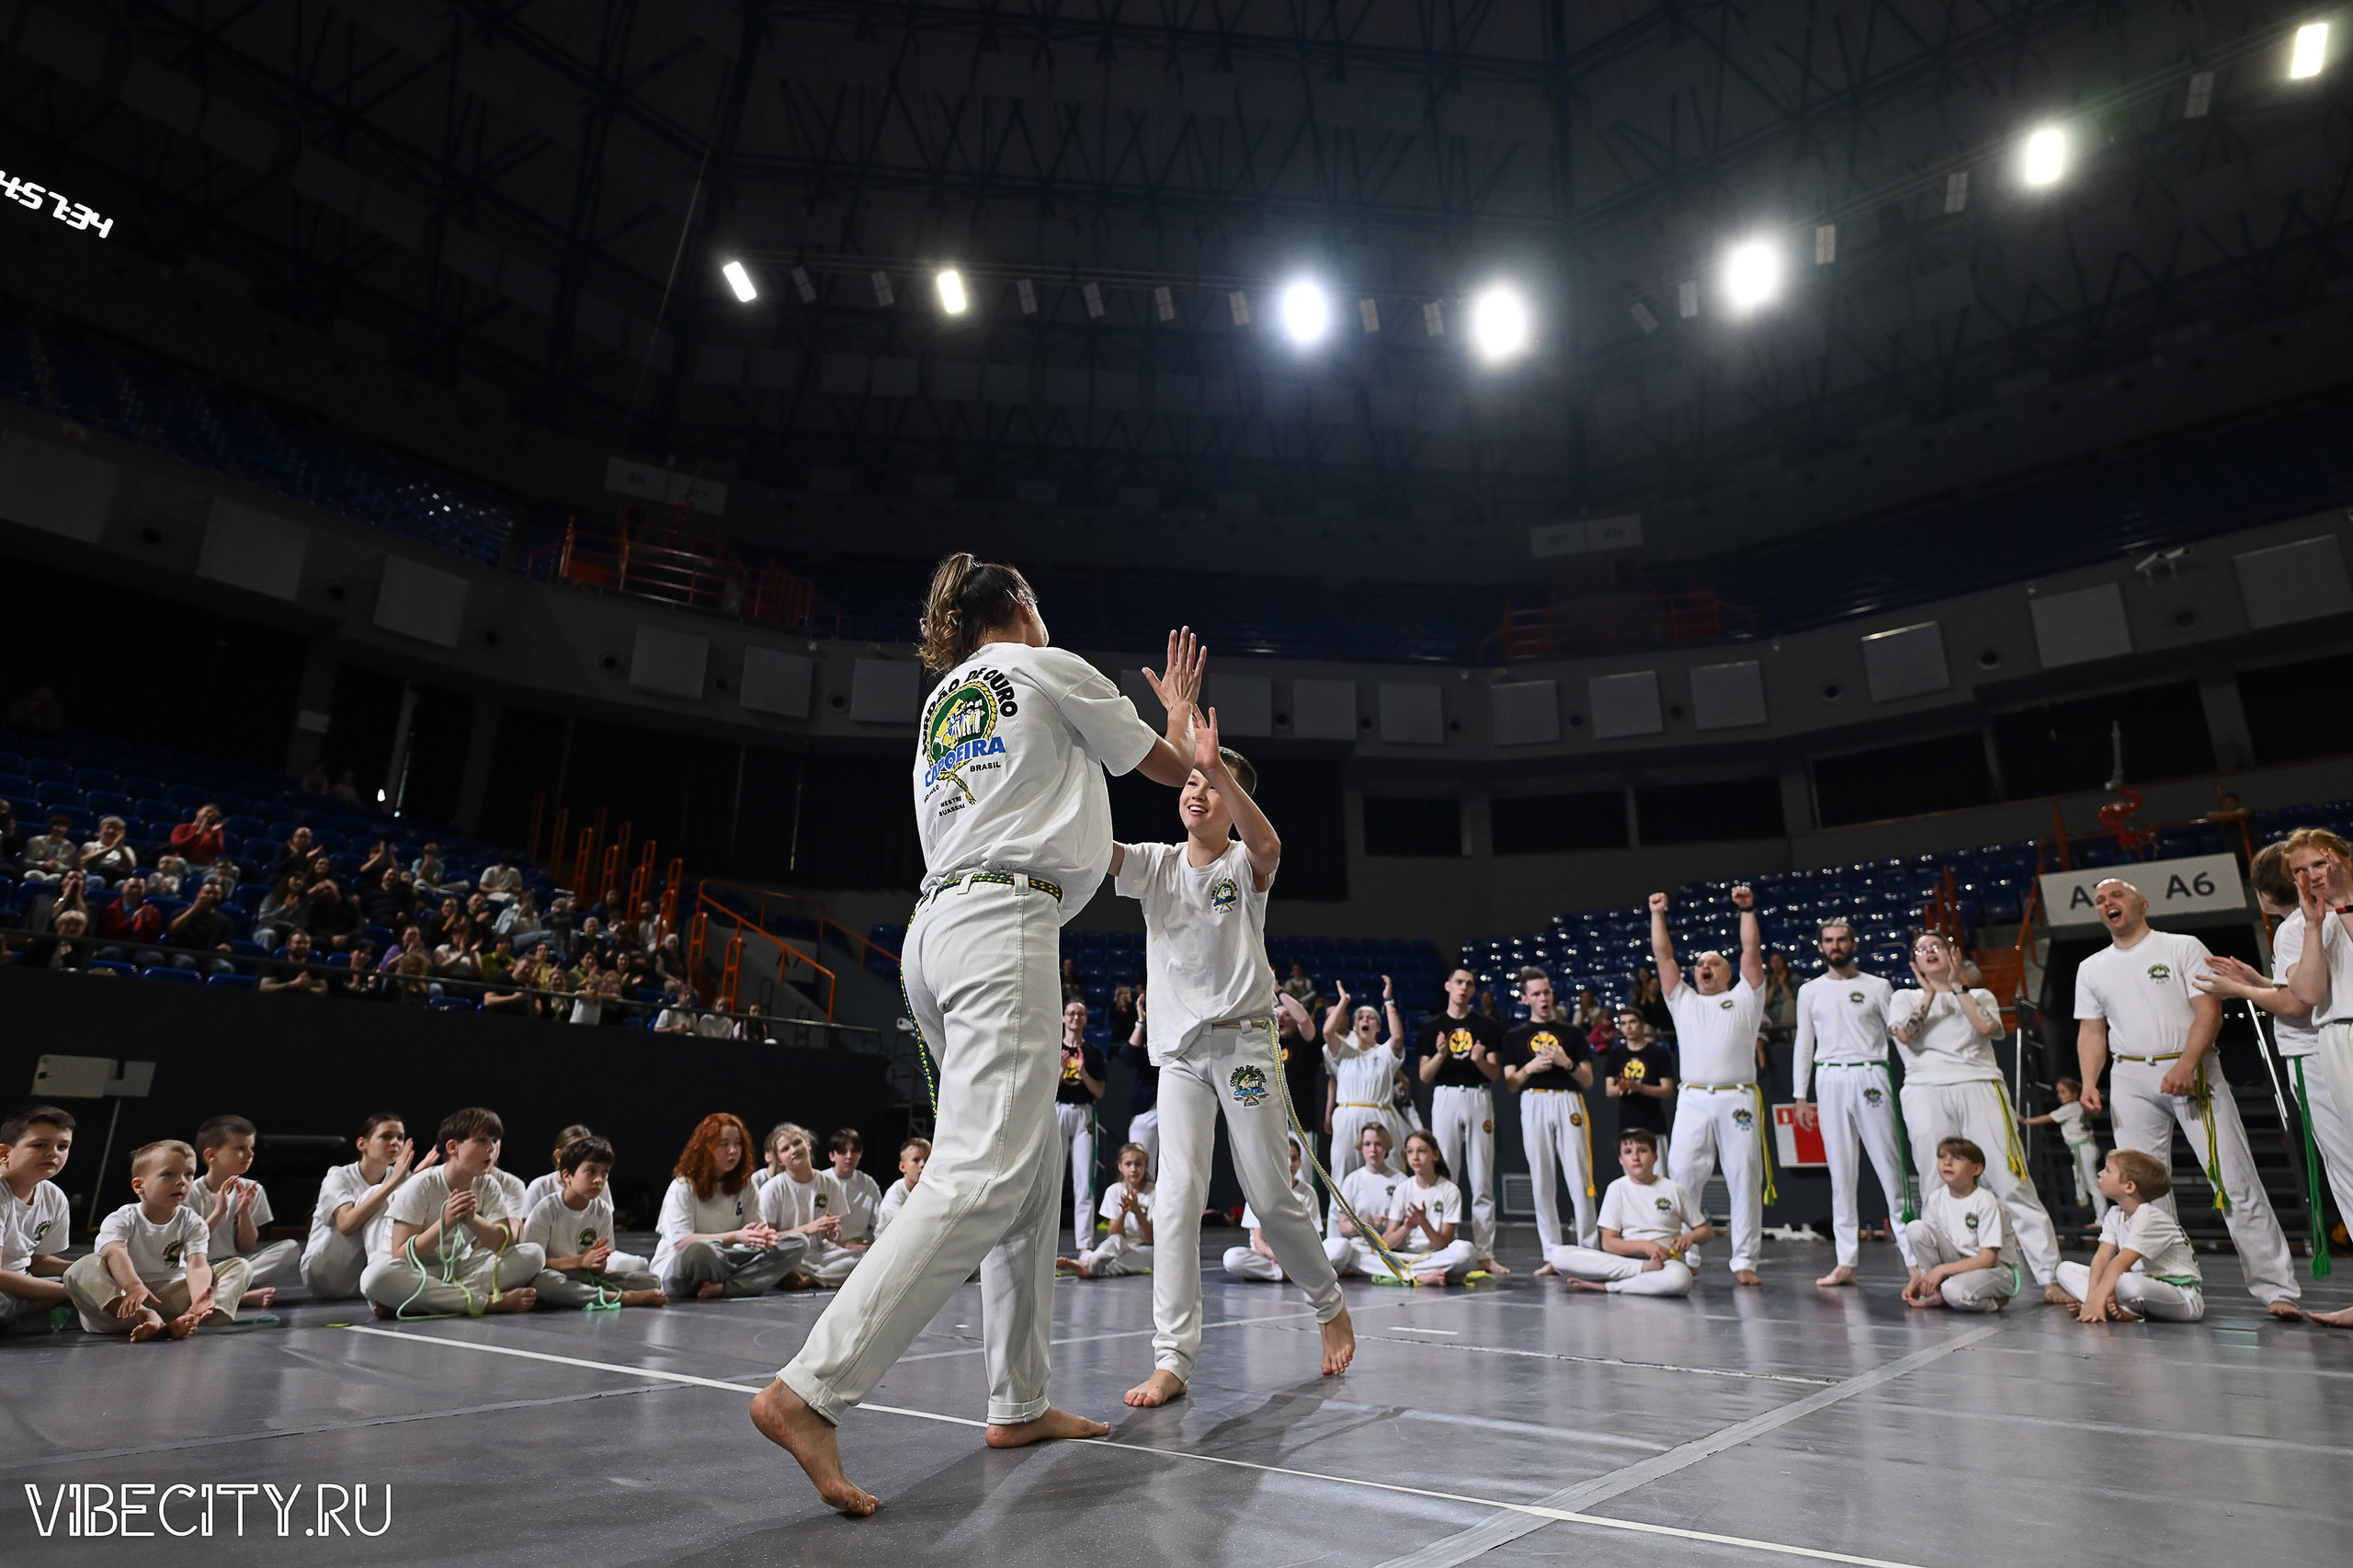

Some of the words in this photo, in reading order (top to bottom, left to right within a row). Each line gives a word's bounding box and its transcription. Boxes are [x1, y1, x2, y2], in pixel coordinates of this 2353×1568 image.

[964, 667, 987, 683] DE
[983, 669, 1017, 717] OURO
[925, 736, 1006, 788] CAPOEIRA
[970, 761, 1001, 772] BRASIL
[2165, 871, 2215, 899] A6
